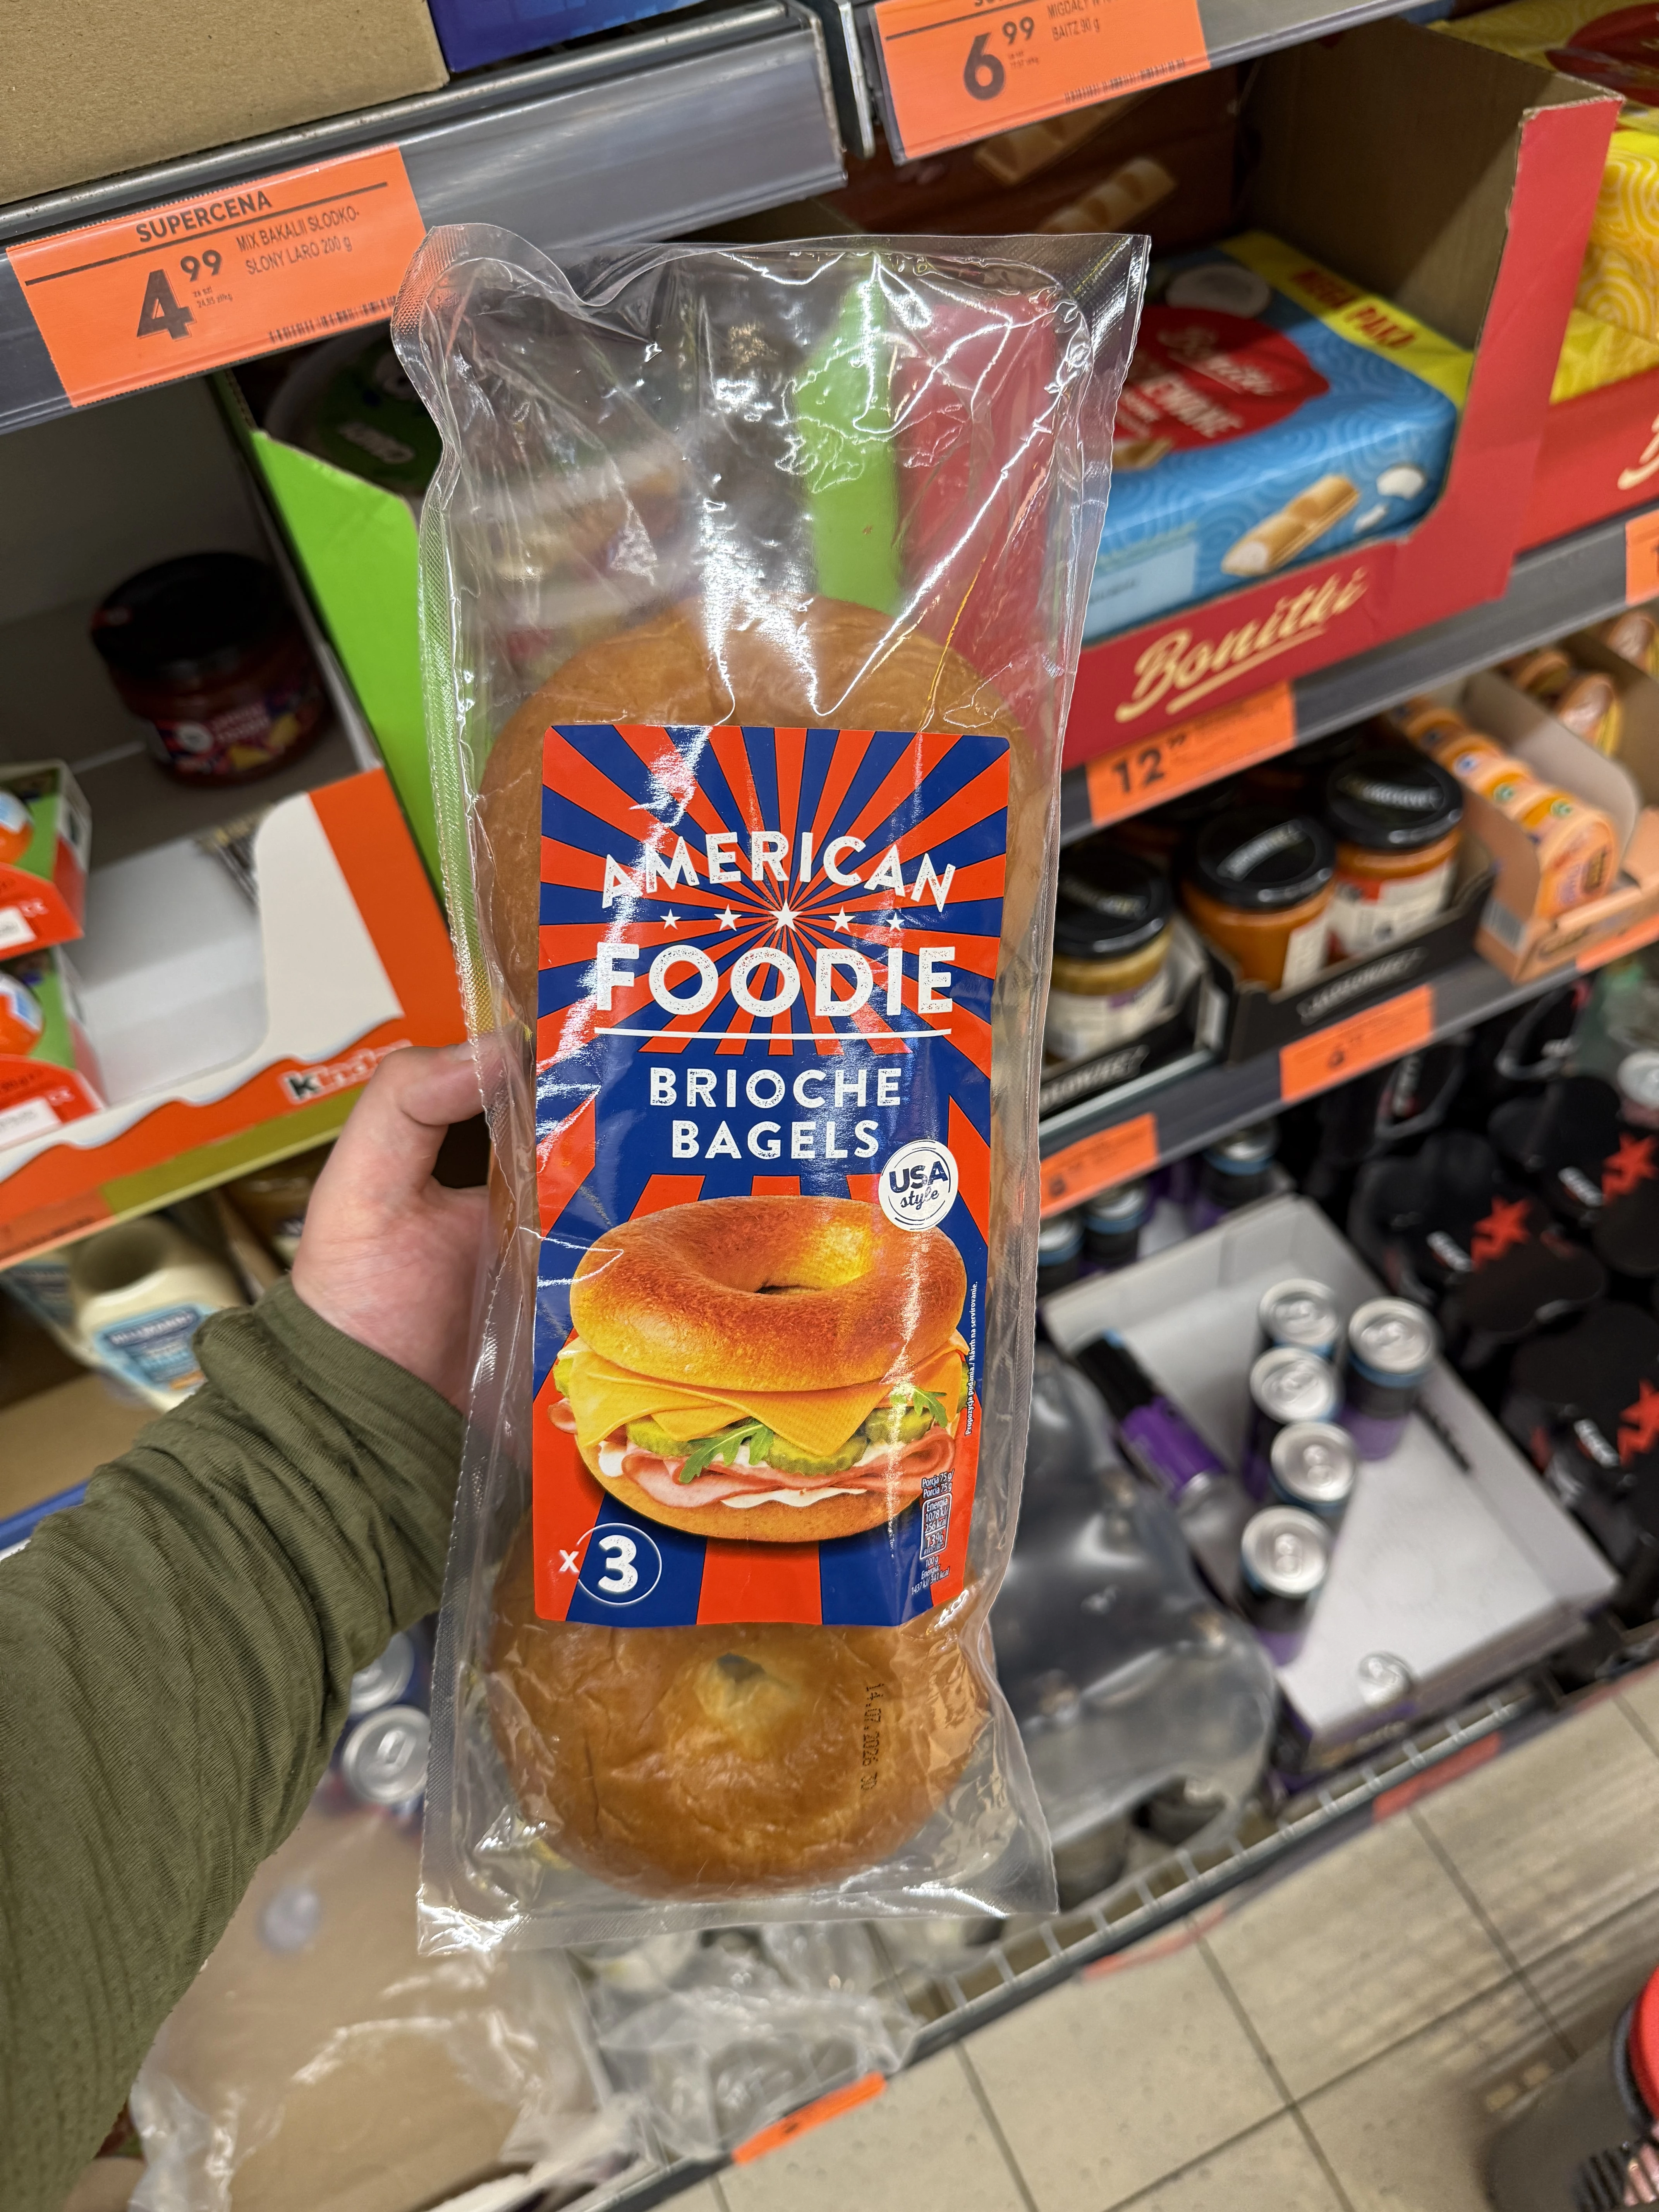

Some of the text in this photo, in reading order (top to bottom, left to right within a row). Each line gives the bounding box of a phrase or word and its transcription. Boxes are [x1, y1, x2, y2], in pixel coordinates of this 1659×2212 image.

[963, 33, 1005, 101] 6
[1002, 16, 1034, 45] 99
[136, 190, 272, 242] SUPERCENA
[236, 232, 260, 252] MIX
[259, 218, 307, 246] BAKALII
[286, 241, 320, 264] LARO
[321, 235, 341, 254] 200
[343, 236, 352, 252] g
[137, 249, 222, 340] 4 99
[1111, 747, 1166, 794] 12
[602, 830, 956, 913] AMERICAN
[596, 941, 955, 1017] FOODIE
[650, 1067, 902, 1108] BRIOCHE
[672, 1120, 879, 1160] BAGELS
[889, 1161, 948, 1193] USA
[900, 1186, 939, 1210] style
[965, 1396, 974, 1435] Propozycja
[971, 1329, 976, 1338] na
[922, 1469, 954, 1487] Porcja 75 g/
[923, 1483, 952, 1498] Porcia 75 g
[926, 1506, 948, 1522] 1078 kJ/
[927, 1497, 948, 1512] Energia
[925, 1516, 947, 1532] 256 kcal
[927, 1530, 943, 1548] 13%
[559, 1535, 638, 1592] x 3
[926, 1556, 939, 1568] 100 g
[912, 1581, 922, 1595] 1437
[939, 1567, 950, 1579] kcal
[862, 1683, 885, 1766] 14.07.2026
